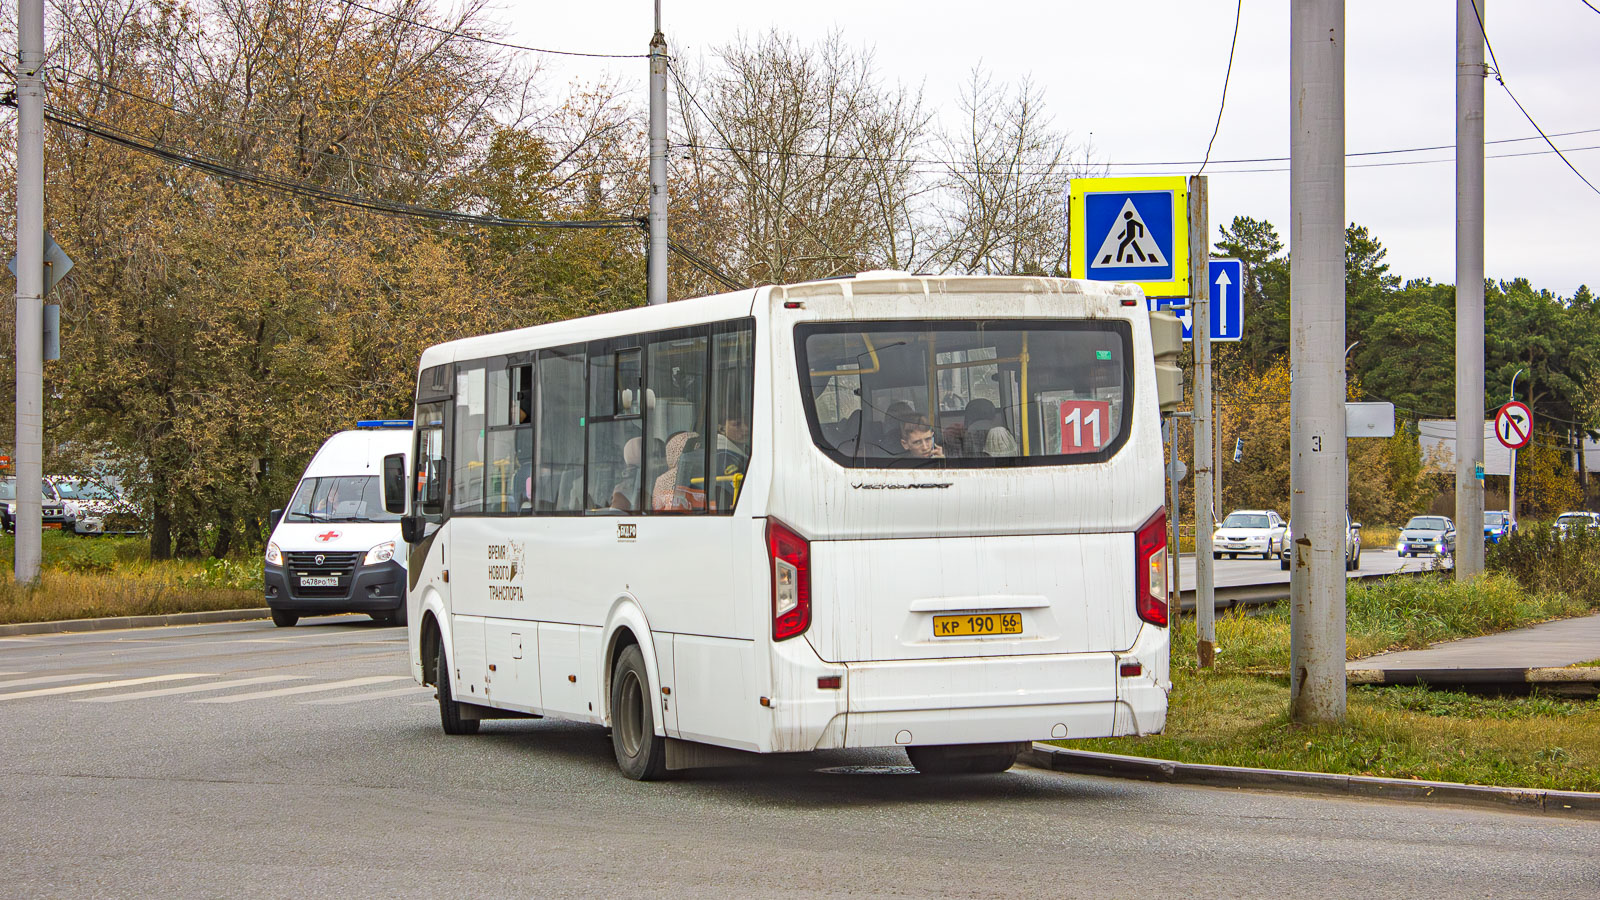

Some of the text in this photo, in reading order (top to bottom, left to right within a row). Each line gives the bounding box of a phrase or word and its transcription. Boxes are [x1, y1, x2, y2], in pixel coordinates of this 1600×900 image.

[1065, 407, 1101, 447] 11
[488, 545, 505, 559] ВРЕМЯ
[488, 565, 509, 580] НОВОГО
[489, 586, 524, 601] ТРАНСПОРТА
[967, 617, 994, 632] 190
[1003, 615, 1016, 627] 66
